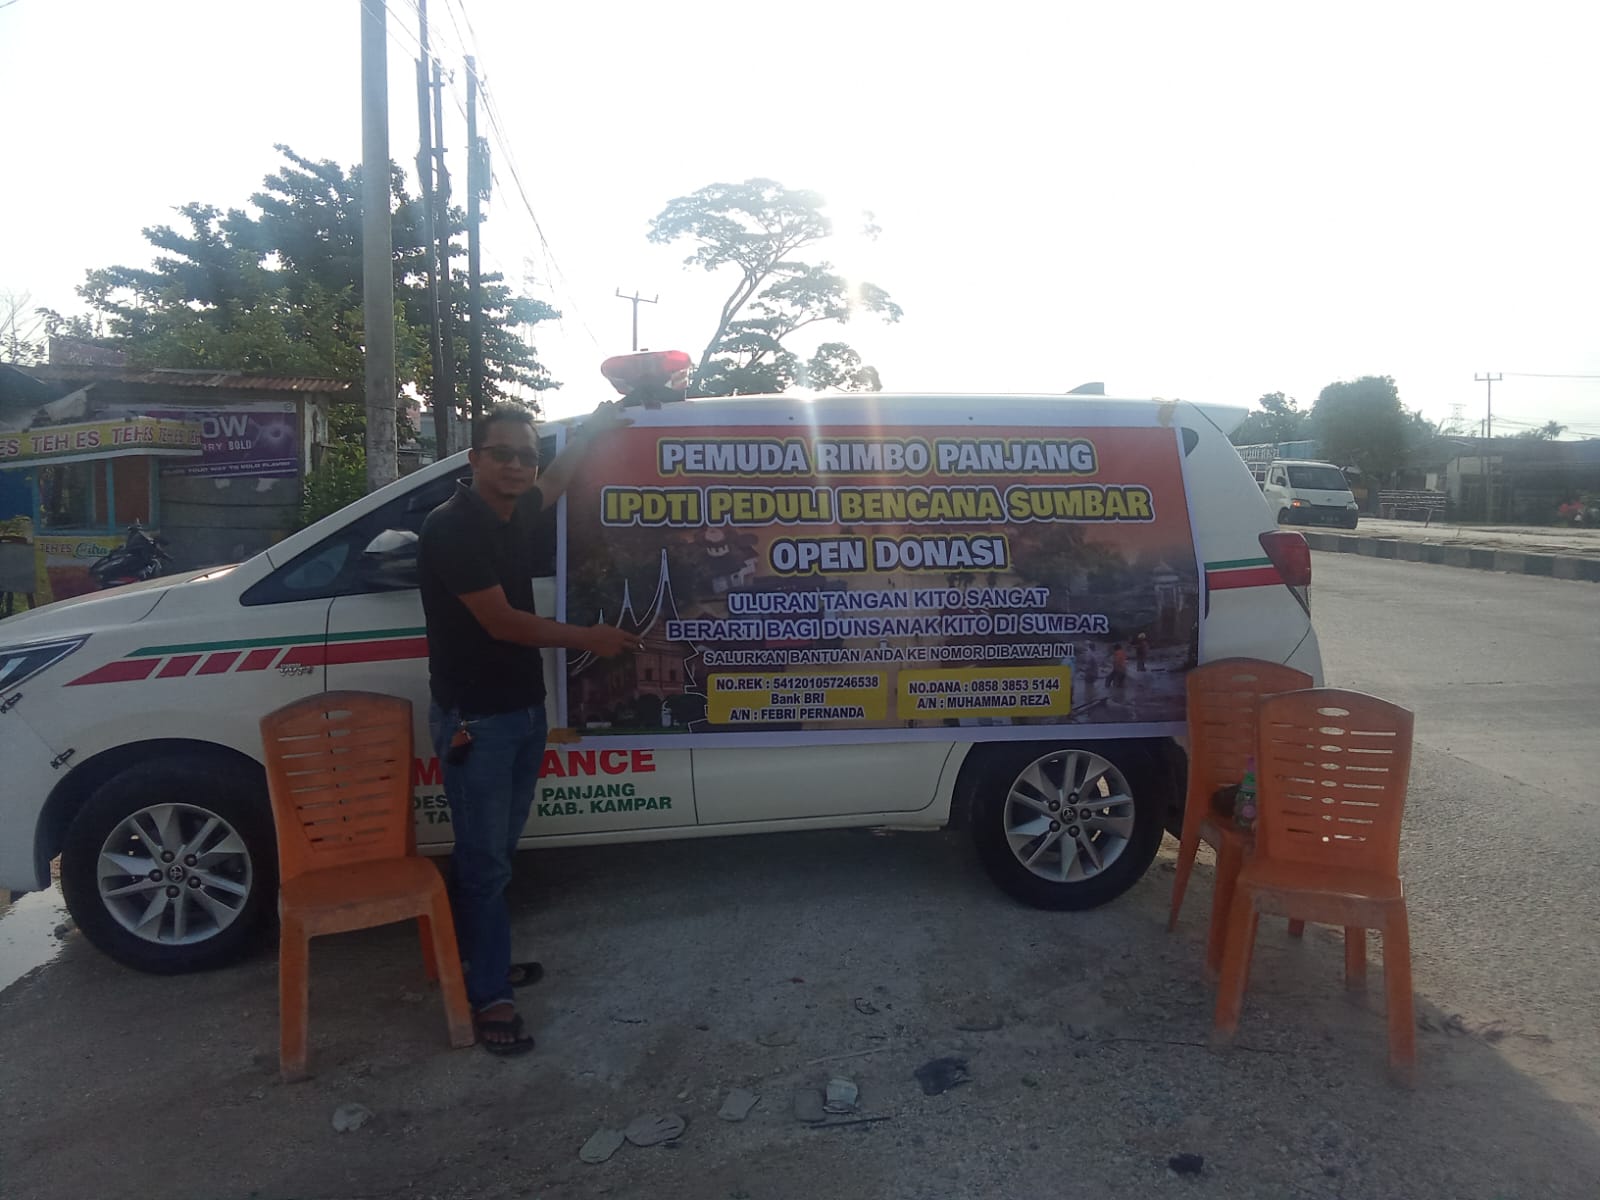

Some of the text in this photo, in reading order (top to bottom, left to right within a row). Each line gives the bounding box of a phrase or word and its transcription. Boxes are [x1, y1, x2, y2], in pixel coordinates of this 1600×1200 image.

[31, 434, 69, 453] TEH
[76, 430, 100, 448] ES
[660, 441, 1095, 473] PEMUDA RIMBO PANJANG
[604, 488, 1153, 523] IPDTI PEDULI BENCANA SUMBAR
[770, 537, 1007, 572] OPEN DONASI
[729, 588, 1048, 613] ULURAN TANGAN KITO SANGAT
[666, 614, 1109, 641] BERARTI BAGI DUNSANAK KITO DI SUMBAR
[703, 643, 1074, 665] SALURKAN BANTUAN ANDA KE NOMOR DIBAWAH INI
[715, 677, 764, 691] NO.REK
[908, 681, 963, 694] NO.DANA
[970, 680, 999, 693] 0858
[1001, 679, 1030, 691] 3853
[1031, 678, 1060, 691] 5144
[770, 691, 825, 705] Bank BRI
[916, 696, 938, 710] A/N
[946, 695, 1017, 709] MUHAMMAD
[1019, 693, 1051, 707] REZA
[729, 708, 751, 721] A/N
[760, 707, 797, 720] FEBRI
[799, 706, 865, 720] PERNANDA
[541, 782, 636, 802] PANJANG
[537, 800, 584, 817] KAB.
[589, 796, 673, 814] KAMPAR
